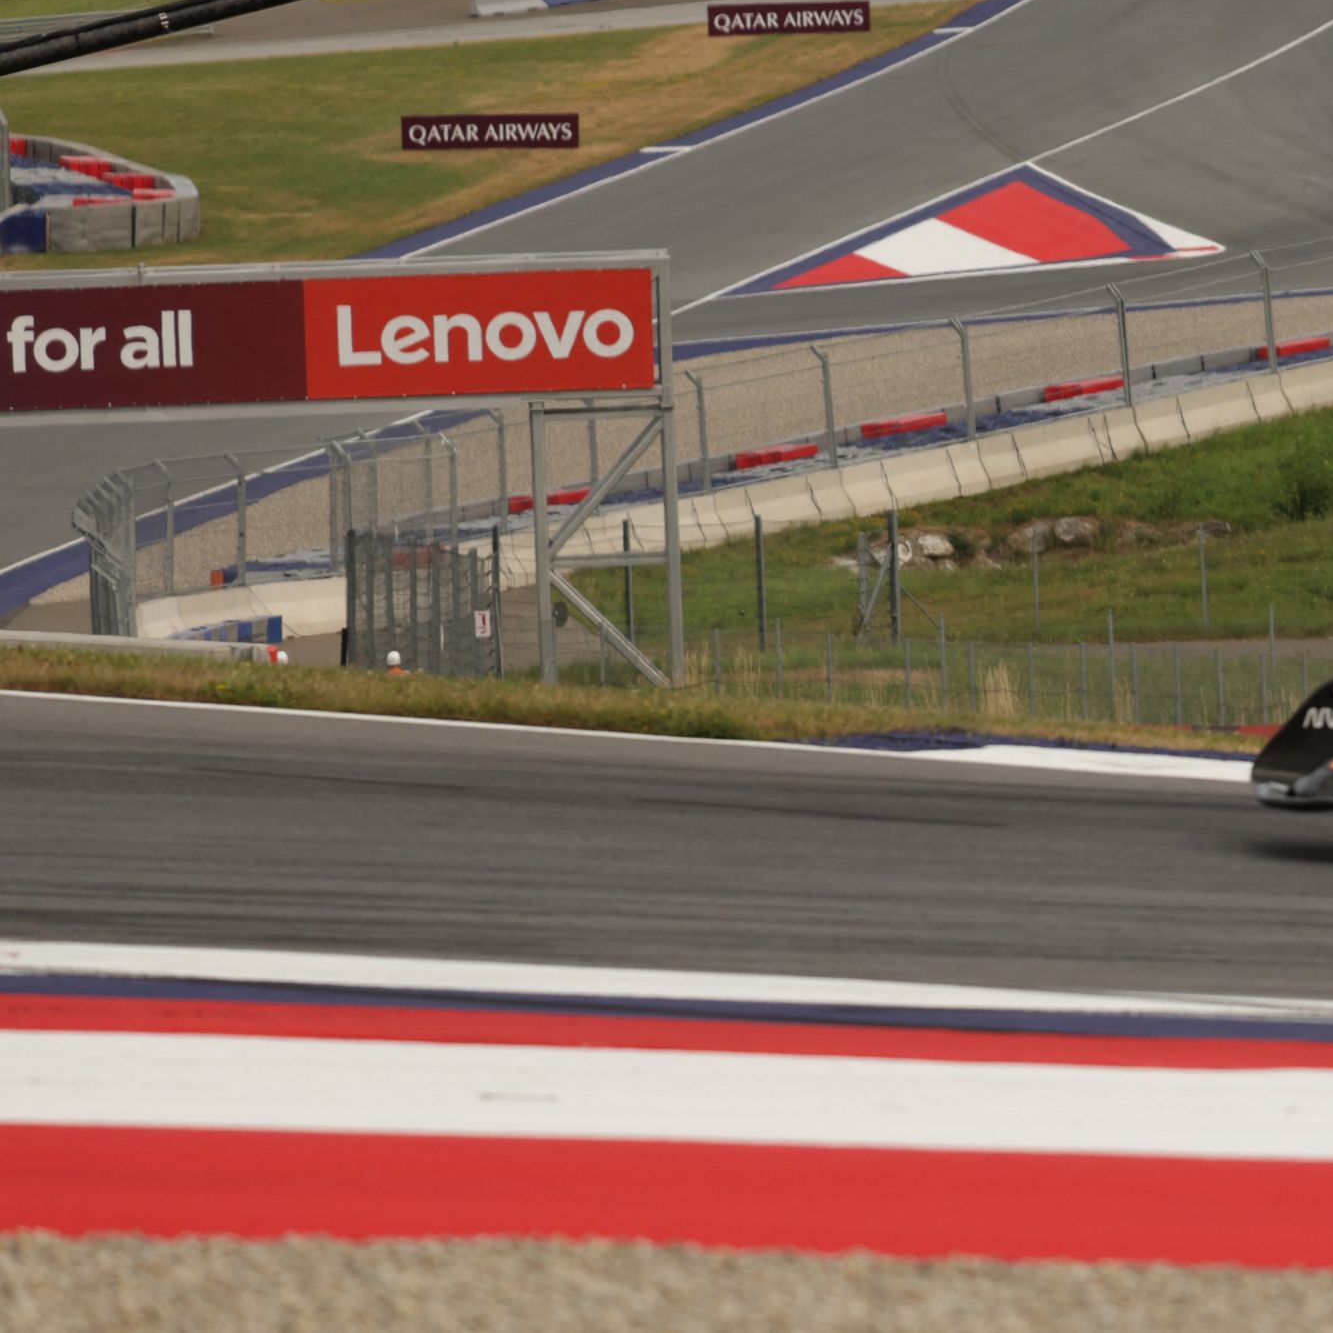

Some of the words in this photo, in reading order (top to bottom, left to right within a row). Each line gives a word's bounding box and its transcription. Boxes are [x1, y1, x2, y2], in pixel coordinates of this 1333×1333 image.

[714, 11, 778, 33] QATAR
[784, 8, 864, 28] AIRWAYS
[408, 124, 479, 146] QATAR
[484, 122, 572, 141] AIRWAYS
[7, 314, 106, 373] for
[120, 309, 194, 369] all
[336, 303, 634, 367] Lenovo
